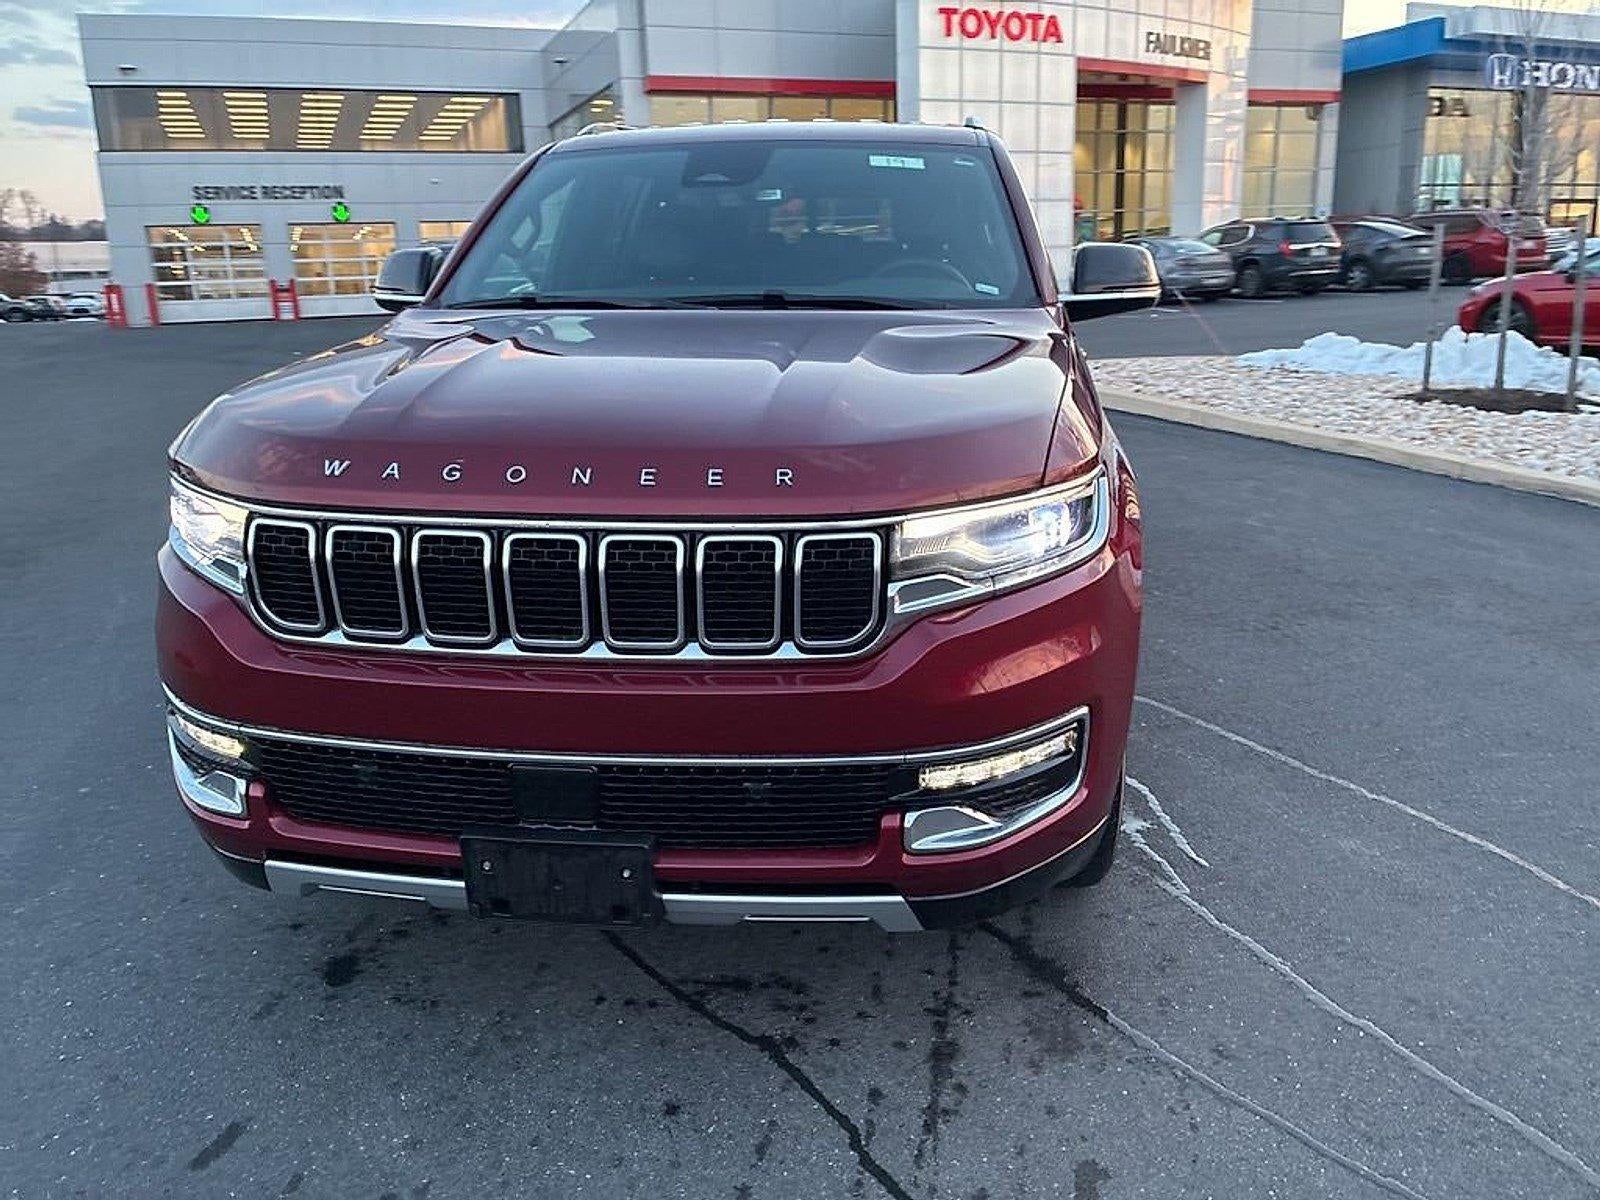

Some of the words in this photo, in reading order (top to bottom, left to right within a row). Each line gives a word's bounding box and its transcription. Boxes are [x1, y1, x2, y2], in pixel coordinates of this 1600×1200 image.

[938, 7, 1063, 43] TOYOTA
[192, 185, 257, 200] SERVICE
[261, 185, 345, 200] RECEPTION
[322, 459, 794, 487] WAGONEER
